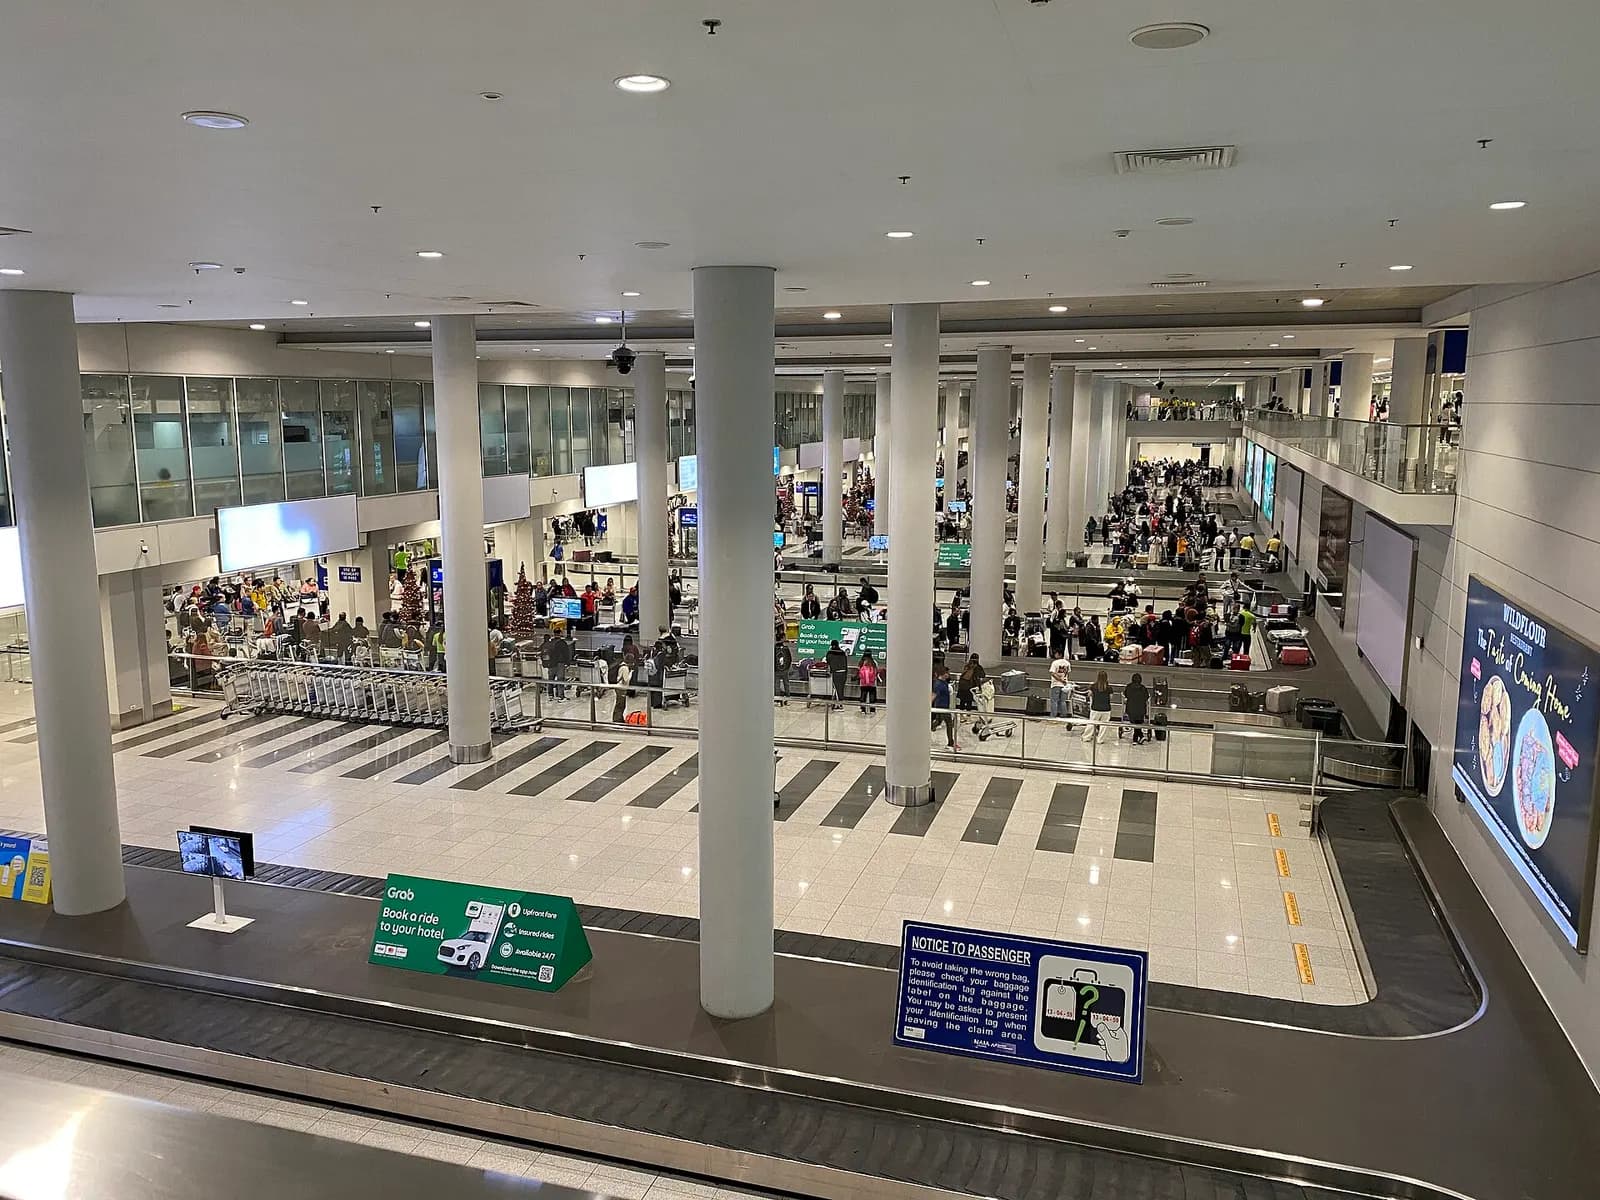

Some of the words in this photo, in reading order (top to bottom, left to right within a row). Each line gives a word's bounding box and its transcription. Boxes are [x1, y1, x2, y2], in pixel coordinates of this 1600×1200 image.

[1503, 603, 1547, 648] WILDFLOUR
[1478, 628, 1487, 650] The
[1487, 629, 1505, 665] Taste
[1505, 654, 1513, 672] of
[1514, 652, 1542, 710] Coming
[1544, 674, 1573, 724] Home.
[387, 886, 415, 901] Grab
[382, 906, 408, 920] Book
[410, 913, 417, 922] a
[418, 912, 440, 925] ride
[522, 908, 545, 918] Upfront
[545, 910, 558, 920] fare
[380, 920, 391, 931] to
[392, 924, 416, 936] your
[417, 925, 445, 940] hotel
[518, 928, 540, 938] Insured
[540, 930, 554, 940] rides
[514, 948, 542, 958] Available
[542, 952, 556, 960] 24/7
[912, 936, 949, 953] NOTICE
[952, 942, 966, 954] TO
[968, 944, 1031, 964] PASSENGER
[910, 958, 920, 966] To
[922, 961, 943, 970] avoid
[944, 962, 968, 975] taking
[970, 967, 983, 976] the
[984, 970, 1010, 980] wrong
[1012, 972, 1030, 983] bag.
[910, 968, 936, 978] please
[941, 972, 964, 982] check
[970, 978, 988, 986] your
[994, 979, 1030, 992] baggage
[908, 977, 957, 991] identification
[962, 985, 975, 995] tag
[980, 988, 1010, 999] against
[1016, 992, 1029, 1002] the
[908, 986, 932, 996] label
[958, 995, 974, 1003] the
[981, 998, 1028, 1012] baggage.
[906, 1006, 924, 1015] your
[929, 1008, 979, 1024] identification
[985, 1018, 998, 1028] tag
[1004, 1021, 1027, 1031] when
[907, 996, 922, 1005] You
[925, 1000, 942, 1010] may
[945, 1001, 955, 1010] be
[958, 1005, 982, 1014] asked
[996, 1011, 1028, 1021] present
[905, 1015, 938, 1028] leaving
[946, 1022, 960, 1031] the
[968, 1025, 994, 1036] claim
[1001, 1031, 1026, 1040] area.
